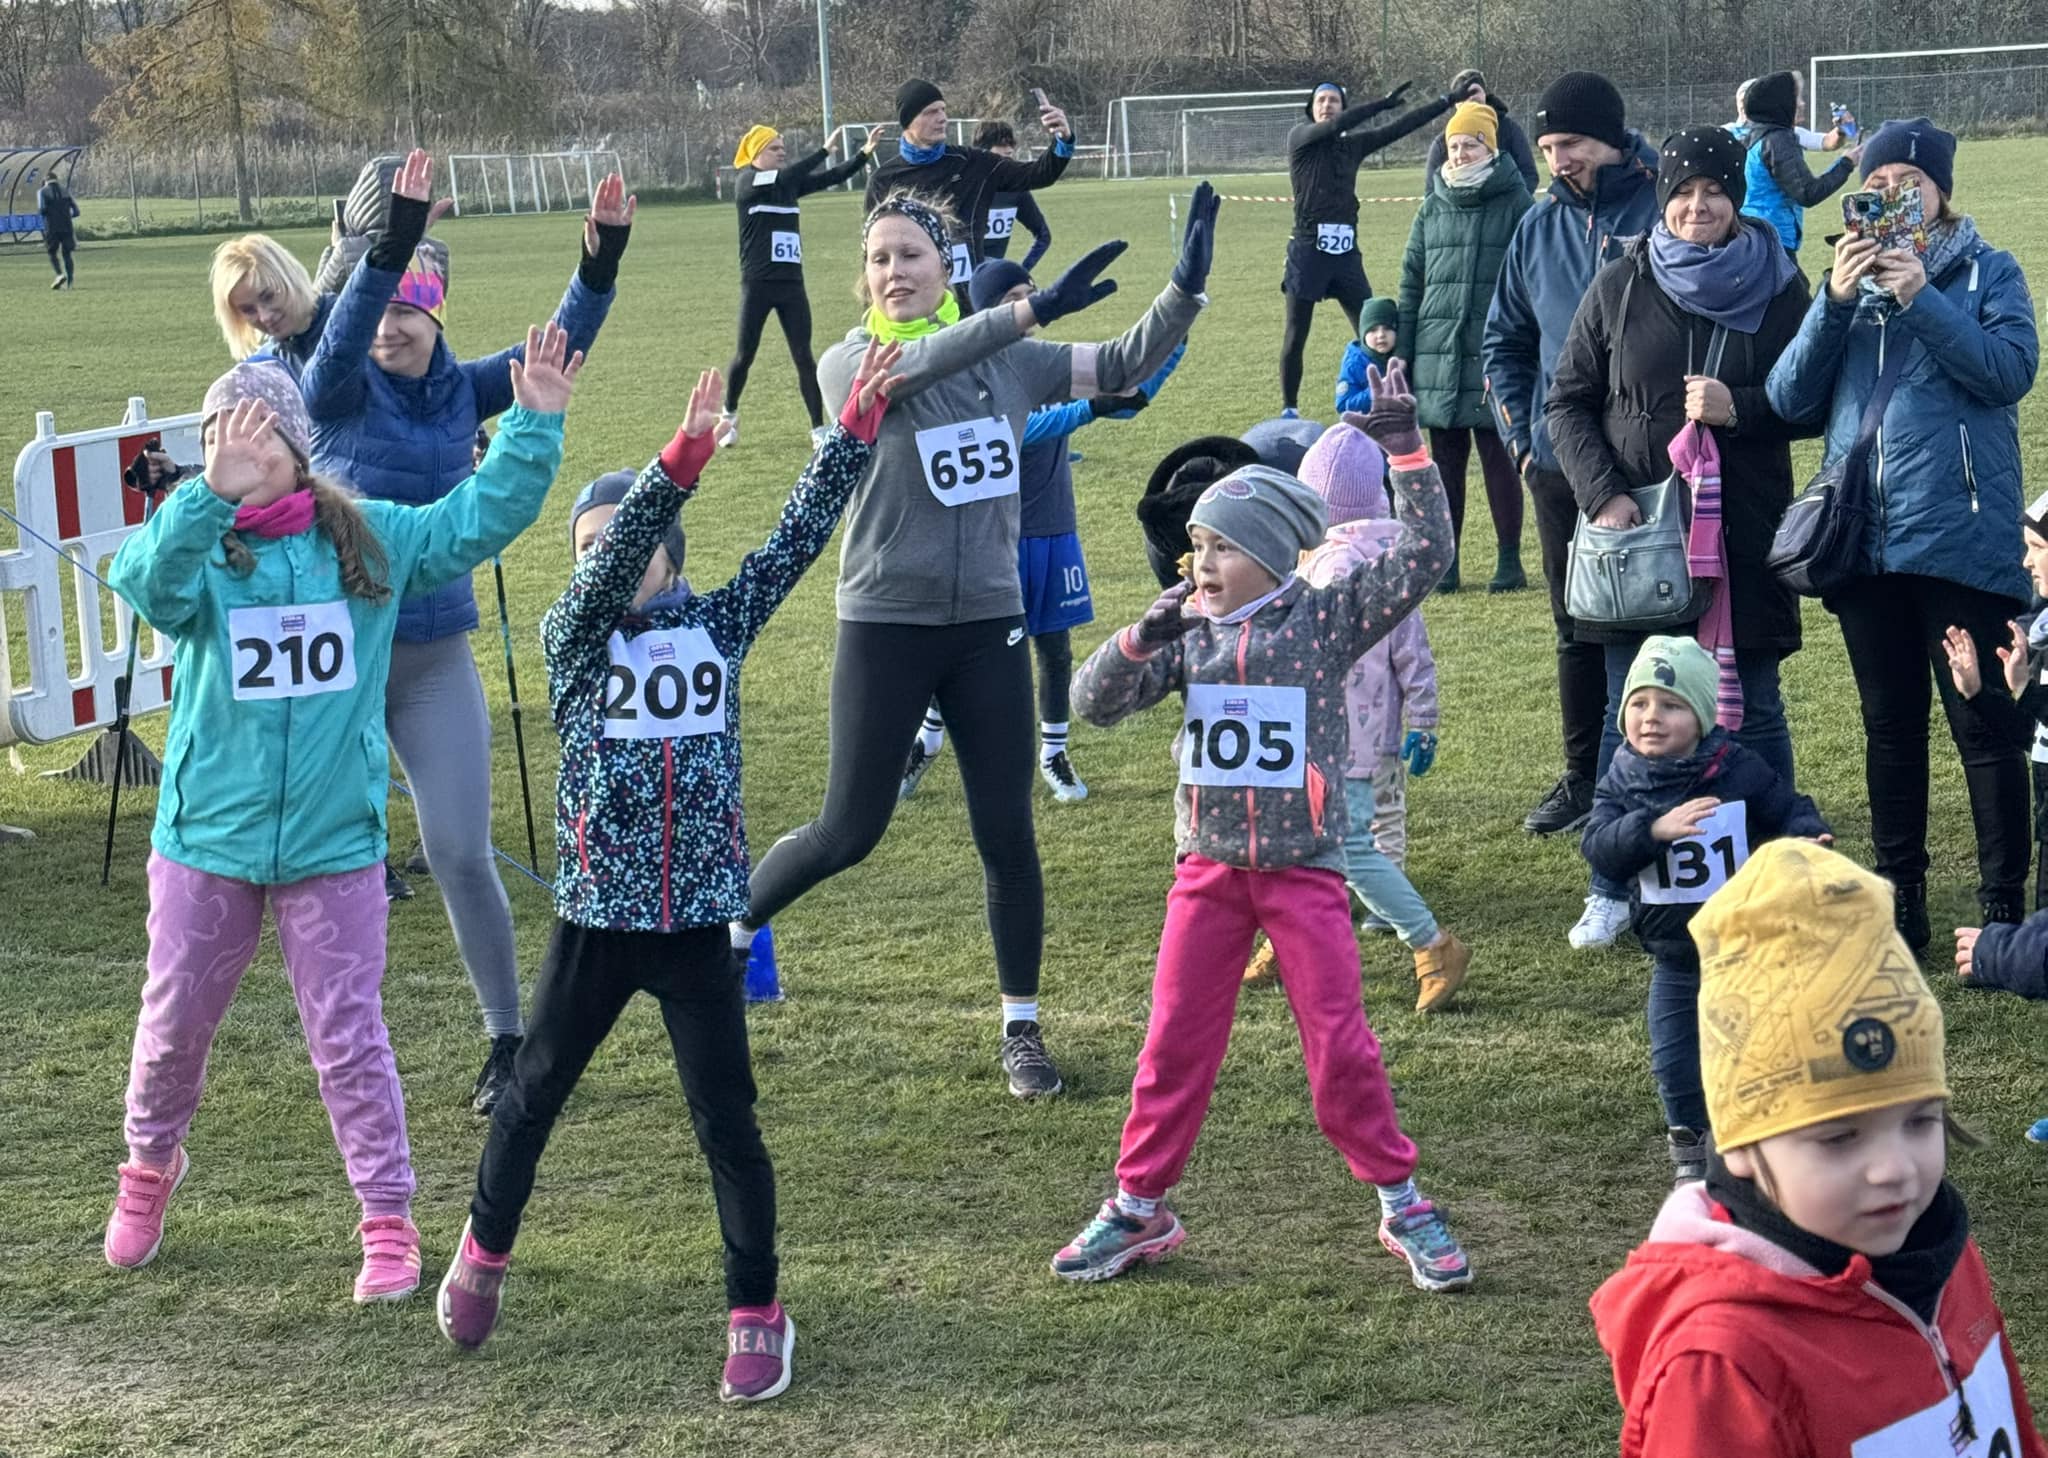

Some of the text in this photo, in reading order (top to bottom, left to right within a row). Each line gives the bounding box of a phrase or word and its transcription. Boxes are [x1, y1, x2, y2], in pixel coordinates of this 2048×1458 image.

[1319, 235, 1351, 251] 620
[931, 439, 1013, 490] 653
[1063, 566, 1083, 594] 10
[235, 632, 343, 688] 210
[605, 661, 722, 719] 209
[1187, 719, 1294, 772] 105
[1655, 834, 1737, 890] 131
